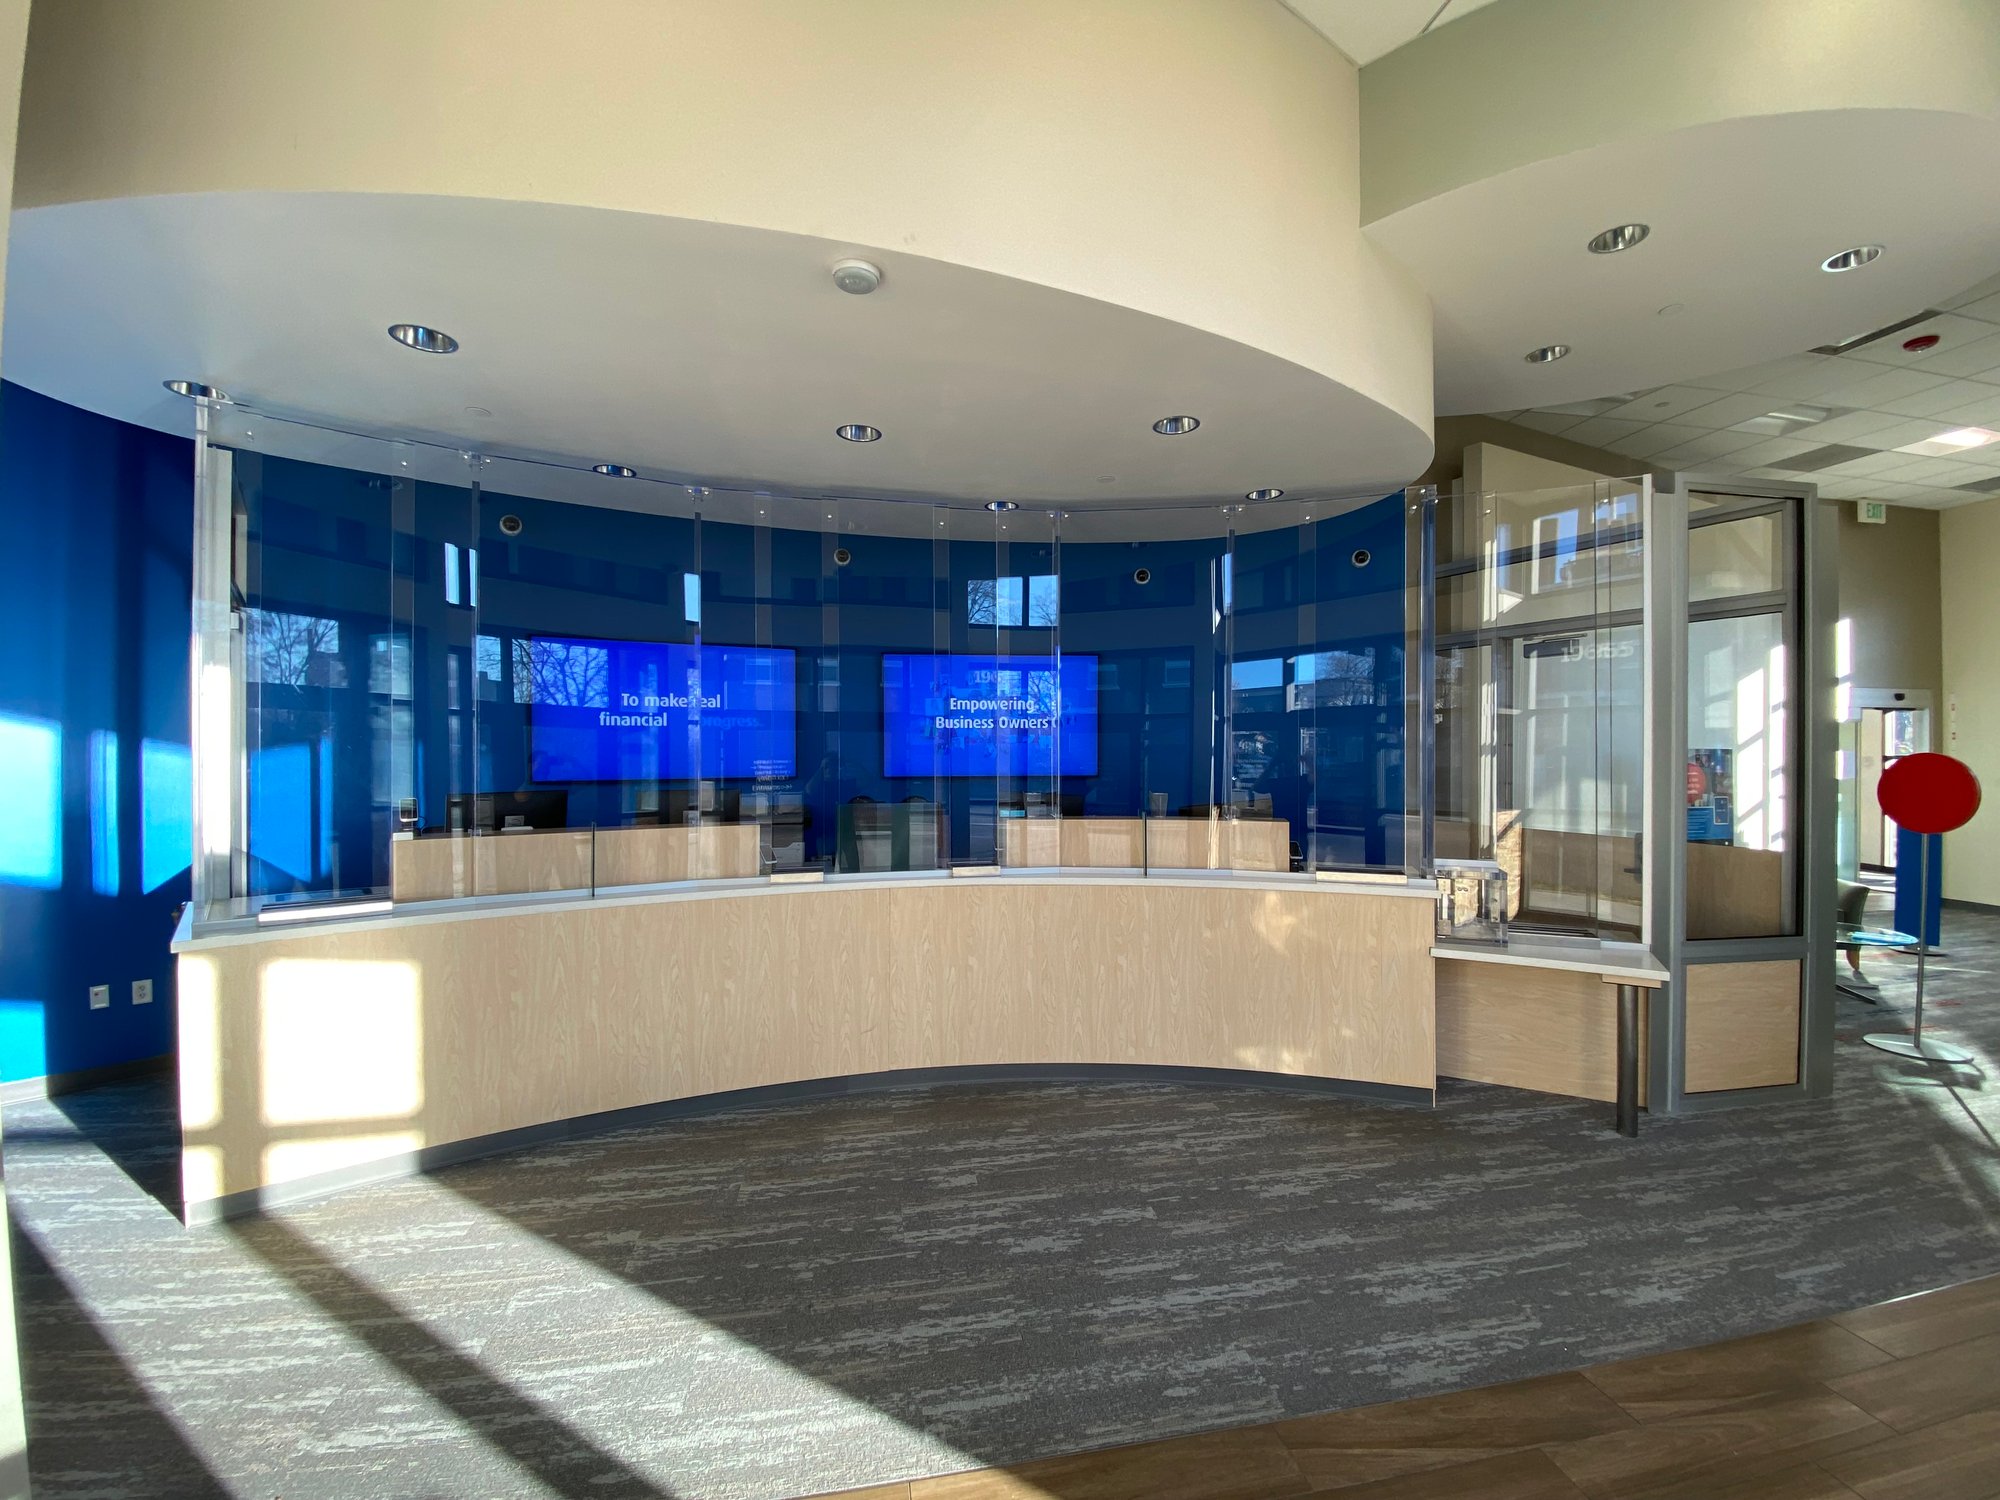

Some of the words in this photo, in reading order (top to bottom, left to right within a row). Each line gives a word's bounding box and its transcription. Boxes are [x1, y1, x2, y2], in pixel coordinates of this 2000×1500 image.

[1867, 503, 1882, 518] EXIT
[621, 693, 639, 707] To
[644, 693, 688, 708] make
[950, 697, 1035, 714] Empowering
[599, 711, 668, 727] financial
[935, 716, 994, 729] Business
[998, 716, 1049, 729] Owners
